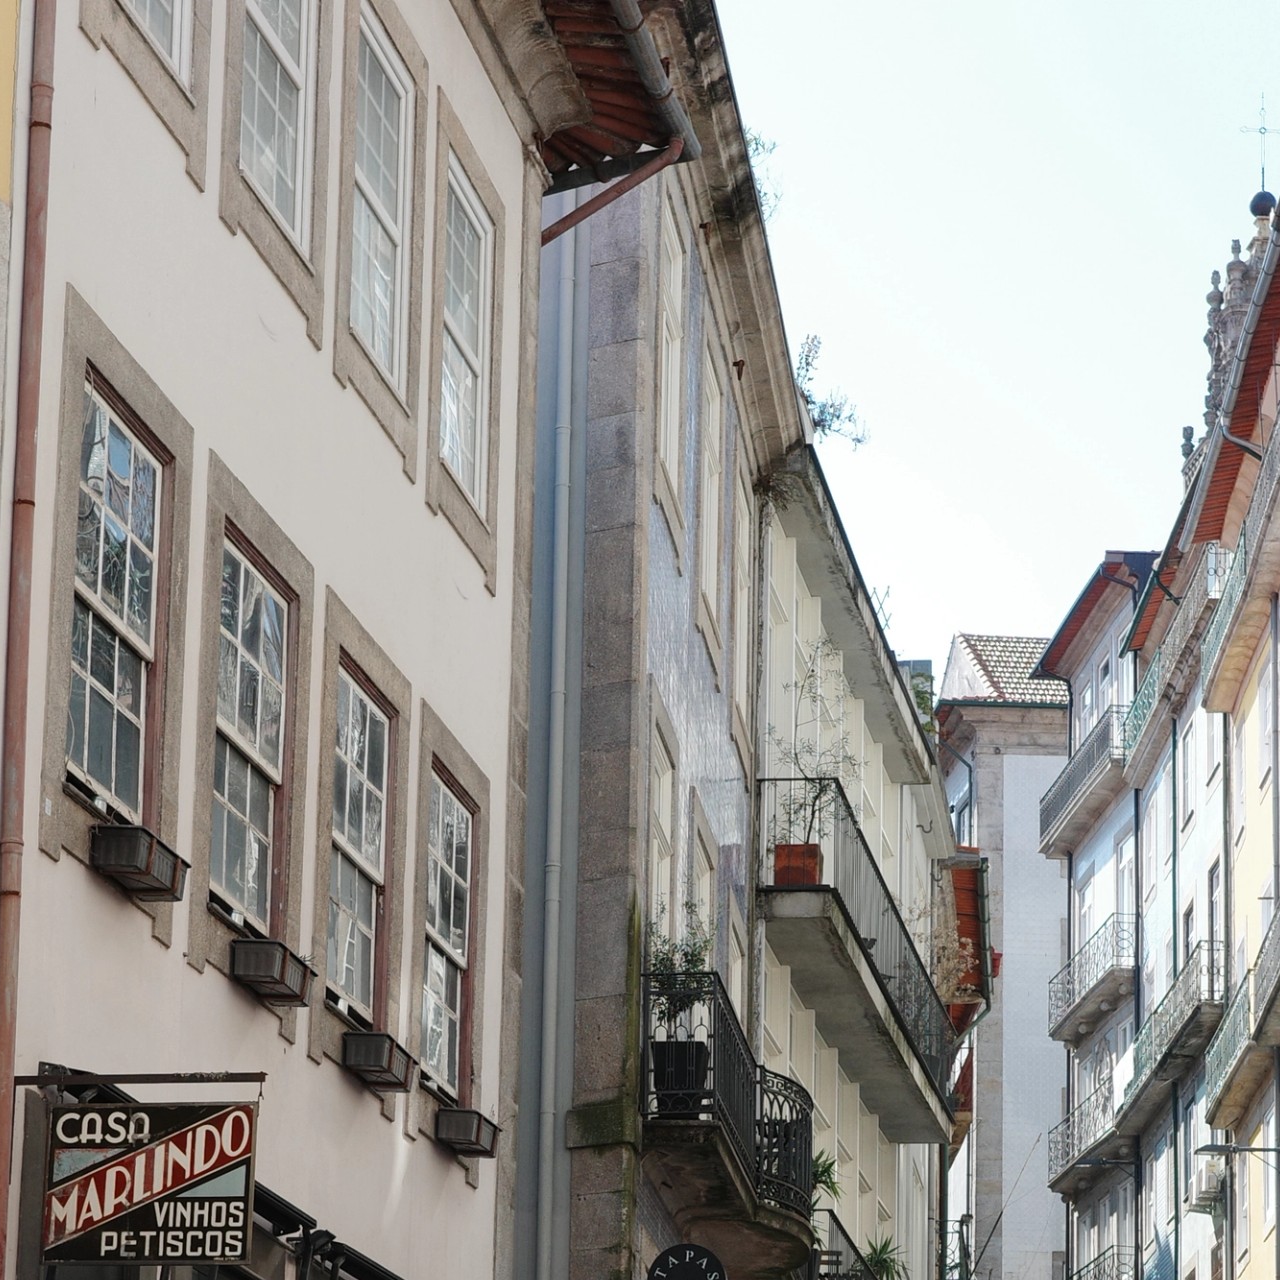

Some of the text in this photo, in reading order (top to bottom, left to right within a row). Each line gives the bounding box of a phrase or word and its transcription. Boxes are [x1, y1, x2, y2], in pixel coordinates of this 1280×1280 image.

[55, 1111, 151, 1145] CASA
[49, 1109, 250, 1244] MARLINDO
[153, 1201, 245, 1228] VINHOS
[100, 1230, 243, 1257] PETISCOS
